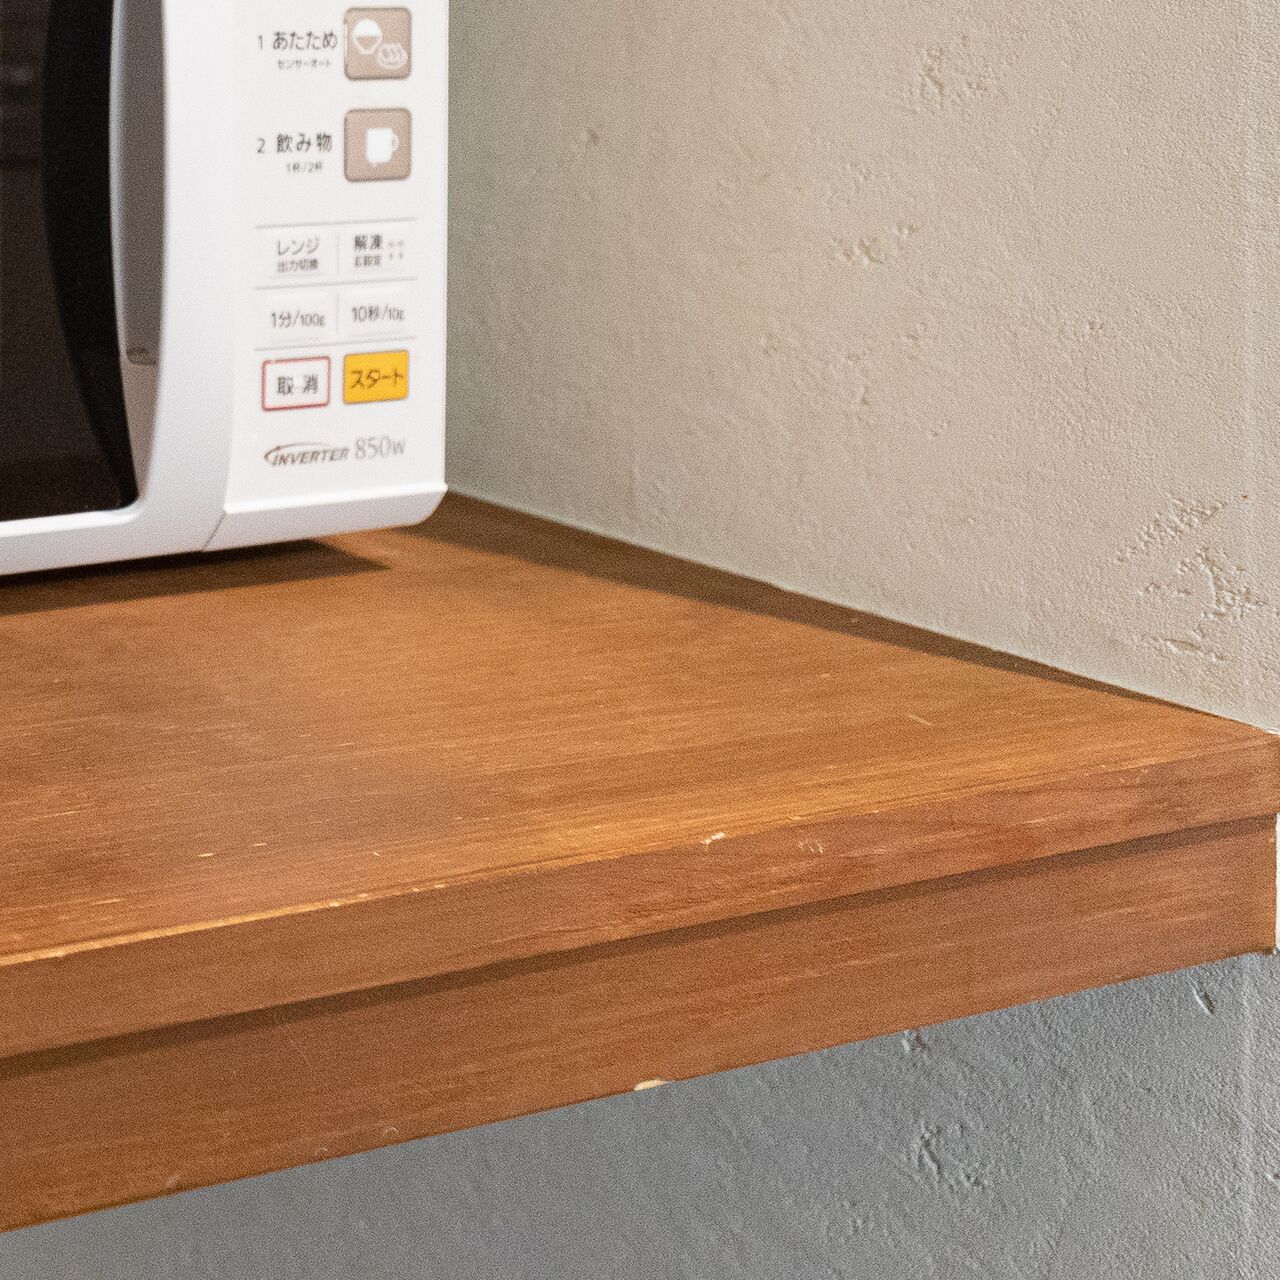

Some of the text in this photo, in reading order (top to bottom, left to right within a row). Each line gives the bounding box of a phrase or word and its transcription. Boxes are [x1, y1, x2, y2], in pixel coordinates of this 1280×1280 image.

[272, 31, 338, 50] あたため
[257, 133, 333, 154] 2 飲み物
[277, 237, 320, 256] レンジ
[351, 368, 404, 390] スタート
[271, 447, 350, 467] INVERTER
